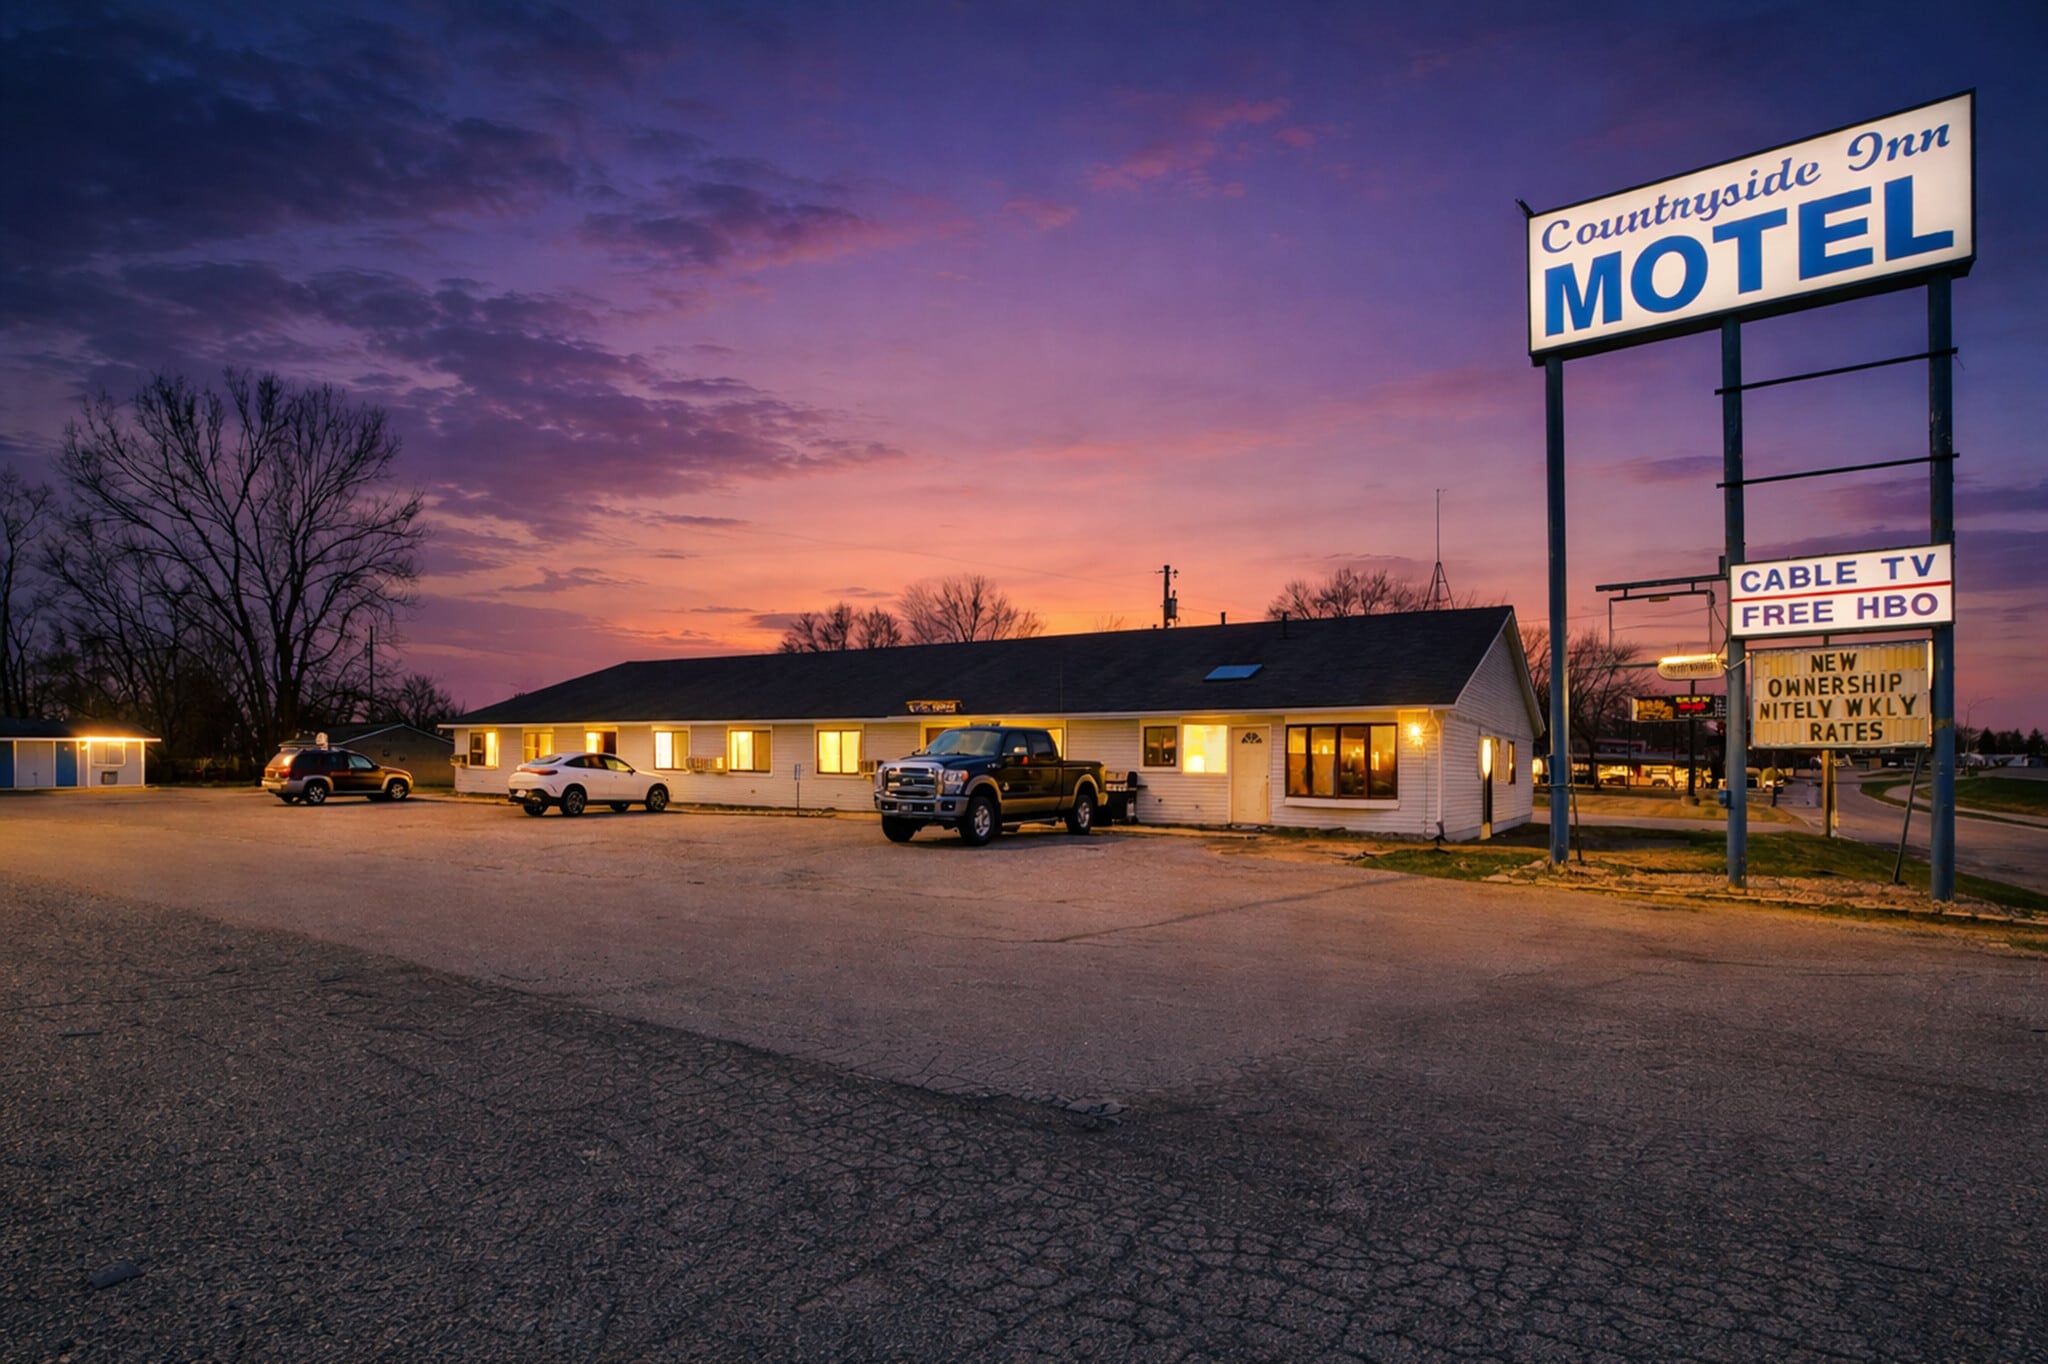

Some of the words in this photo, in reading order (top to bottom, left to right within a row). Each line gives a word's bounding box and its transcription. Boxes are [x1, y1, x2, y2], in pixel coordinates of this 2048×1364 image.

[1541, 156, 1822, 253] Countryside
[1847, 123, 1950, 171] Inn
[1544, 174, 1954, 338] MOTEL
[1740, 560, 1858, 593] CABLE
[1880, 553, 1936, 580] TV
[1742, 600, 1834, 628] FREE
[1856, 592, 1939, 620] HBO
[1811, 652, 1858, 673] NEW
[1768, 673, 1902, 698] OWNERSHIP
[1759, 700, 1833, 721] NITELY
[1847, 695, 1917, 717] WKLY
[1810, 721, 1884, 742] RATES
